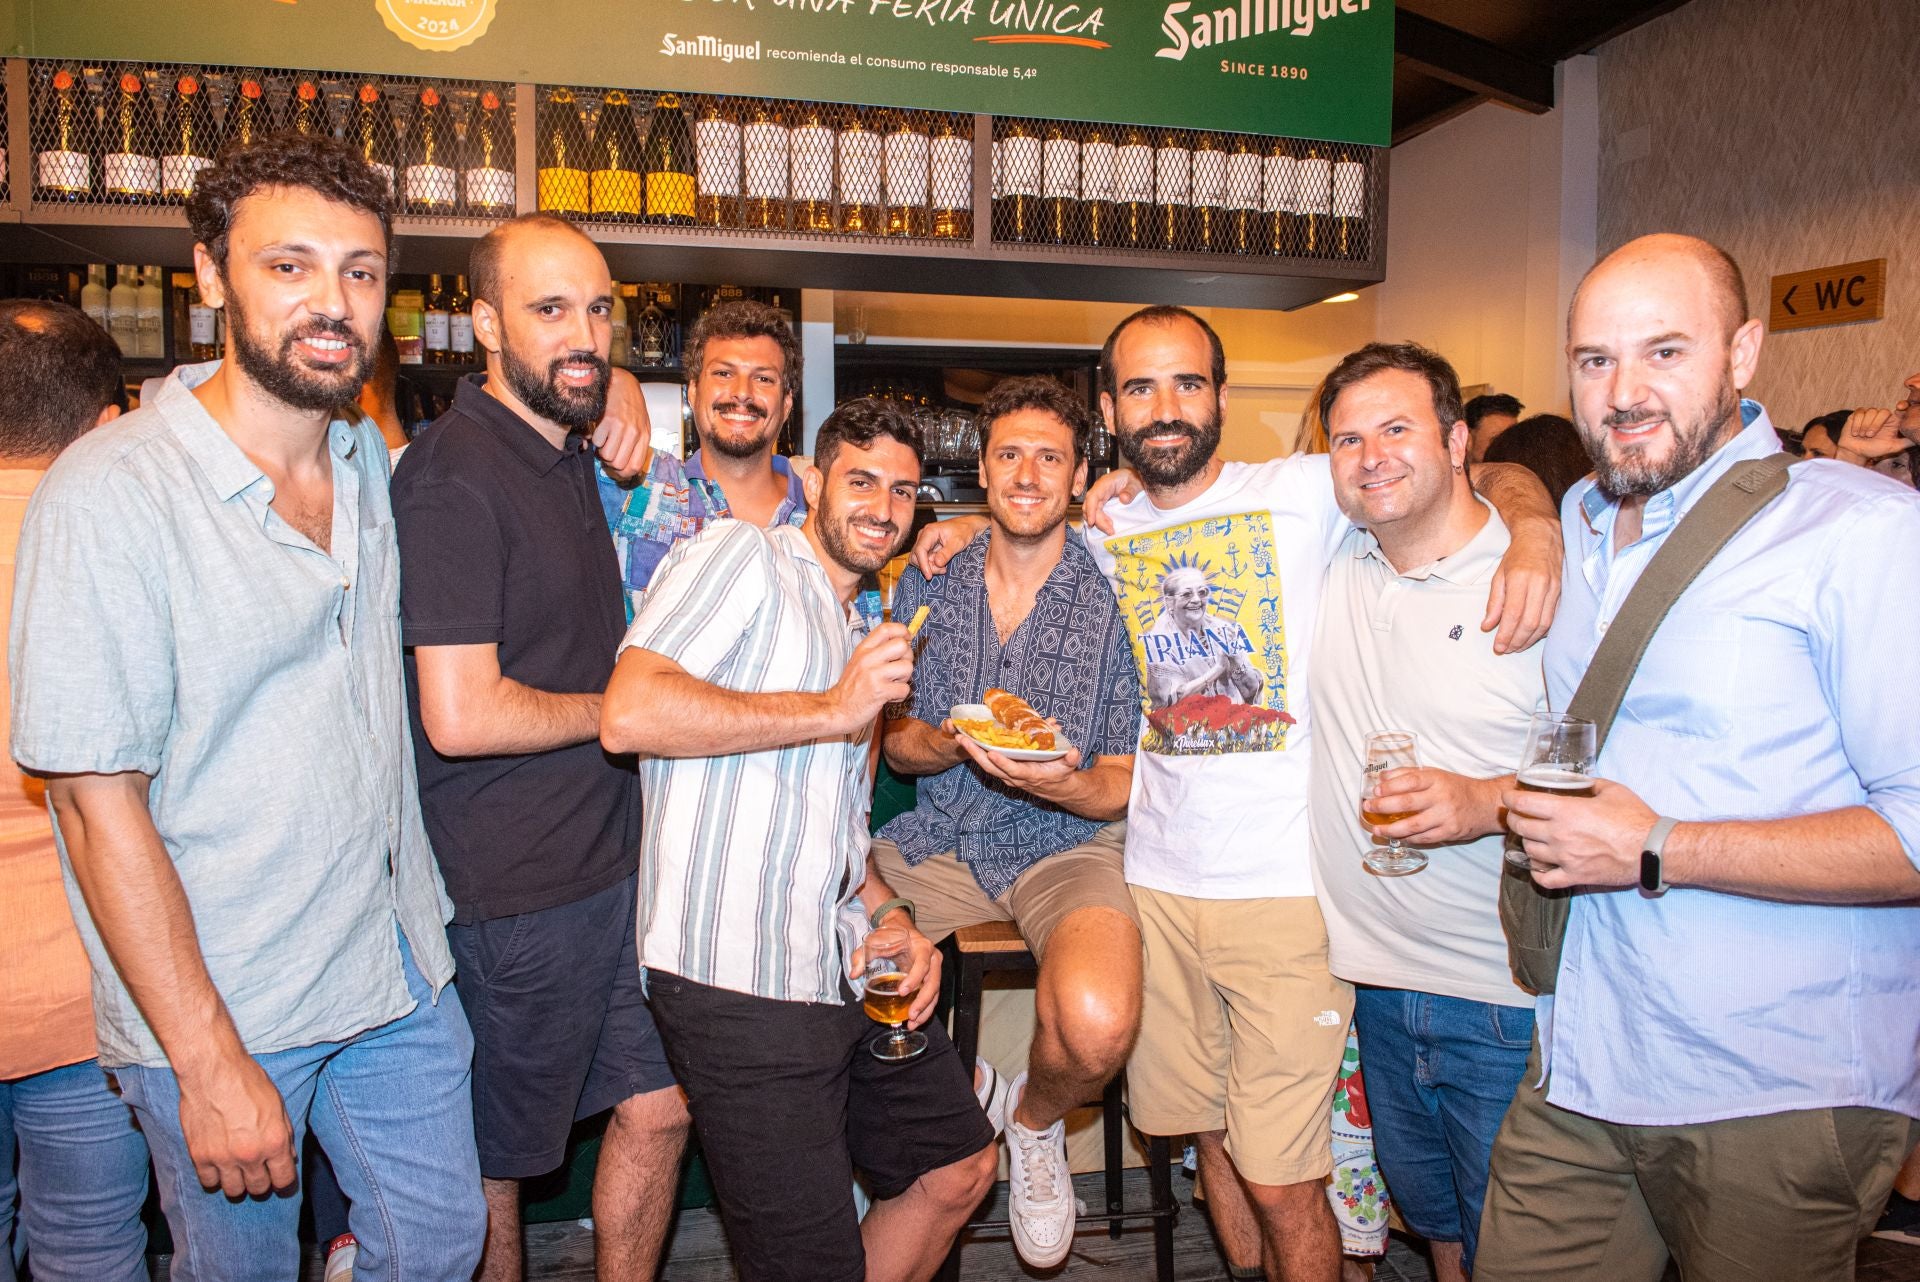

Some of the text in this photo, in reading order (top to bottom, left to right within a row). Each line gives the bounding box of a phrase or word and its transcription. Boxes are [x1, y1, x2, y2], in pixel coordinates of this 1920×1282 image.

[417, 16, 460, 34] 2024
[1154, 0, 1370, 61] SanMigu
[659, 32, 760, 63] SanMiguel
[766, 48, 846, 65] recomienda
[850, 53, 862, 66] el
[866, 55, 927, 71] consumo
[931, 61, 1009, 77] responsable
[1220, 59, 1309, 80] SINCE 1890
[1815, 275, 1866, 311] WC
[1137, 623, 1256, 665] TRIANA
